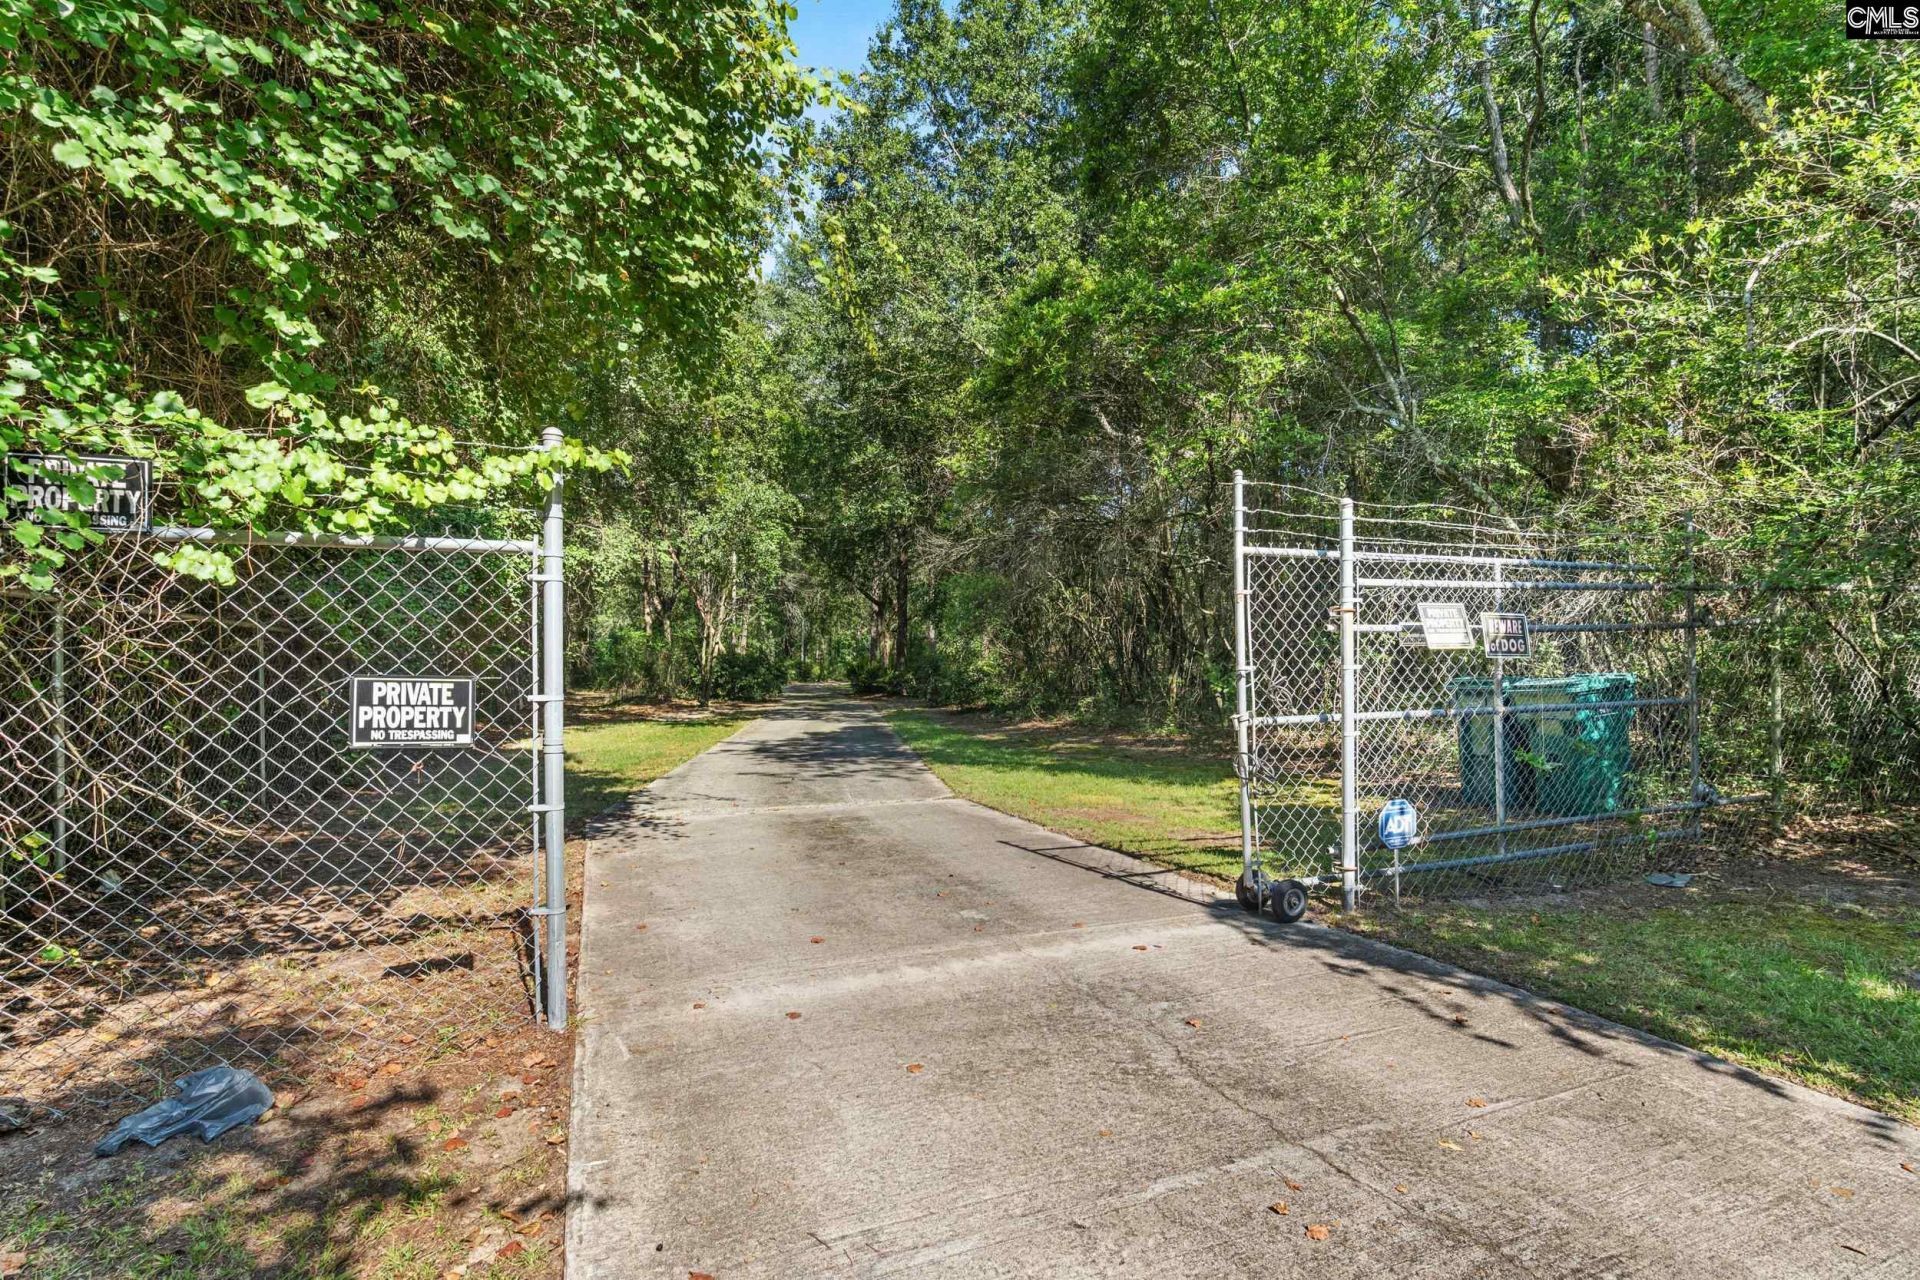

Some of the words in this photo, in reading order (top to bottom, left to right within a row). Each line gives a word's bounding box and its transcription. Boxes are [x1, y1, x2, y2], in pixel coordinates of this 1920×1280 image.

[1501, 639, 1526, 652] DOG
[372, 682, 454, 706] PRIVATE
[358, 705, 467, 729] PROPERTY
[370, 729, 386, 740] NO
[388, 729, 455, 740] TRESPASSING
[1384, 814, 1412, 834] ADT
